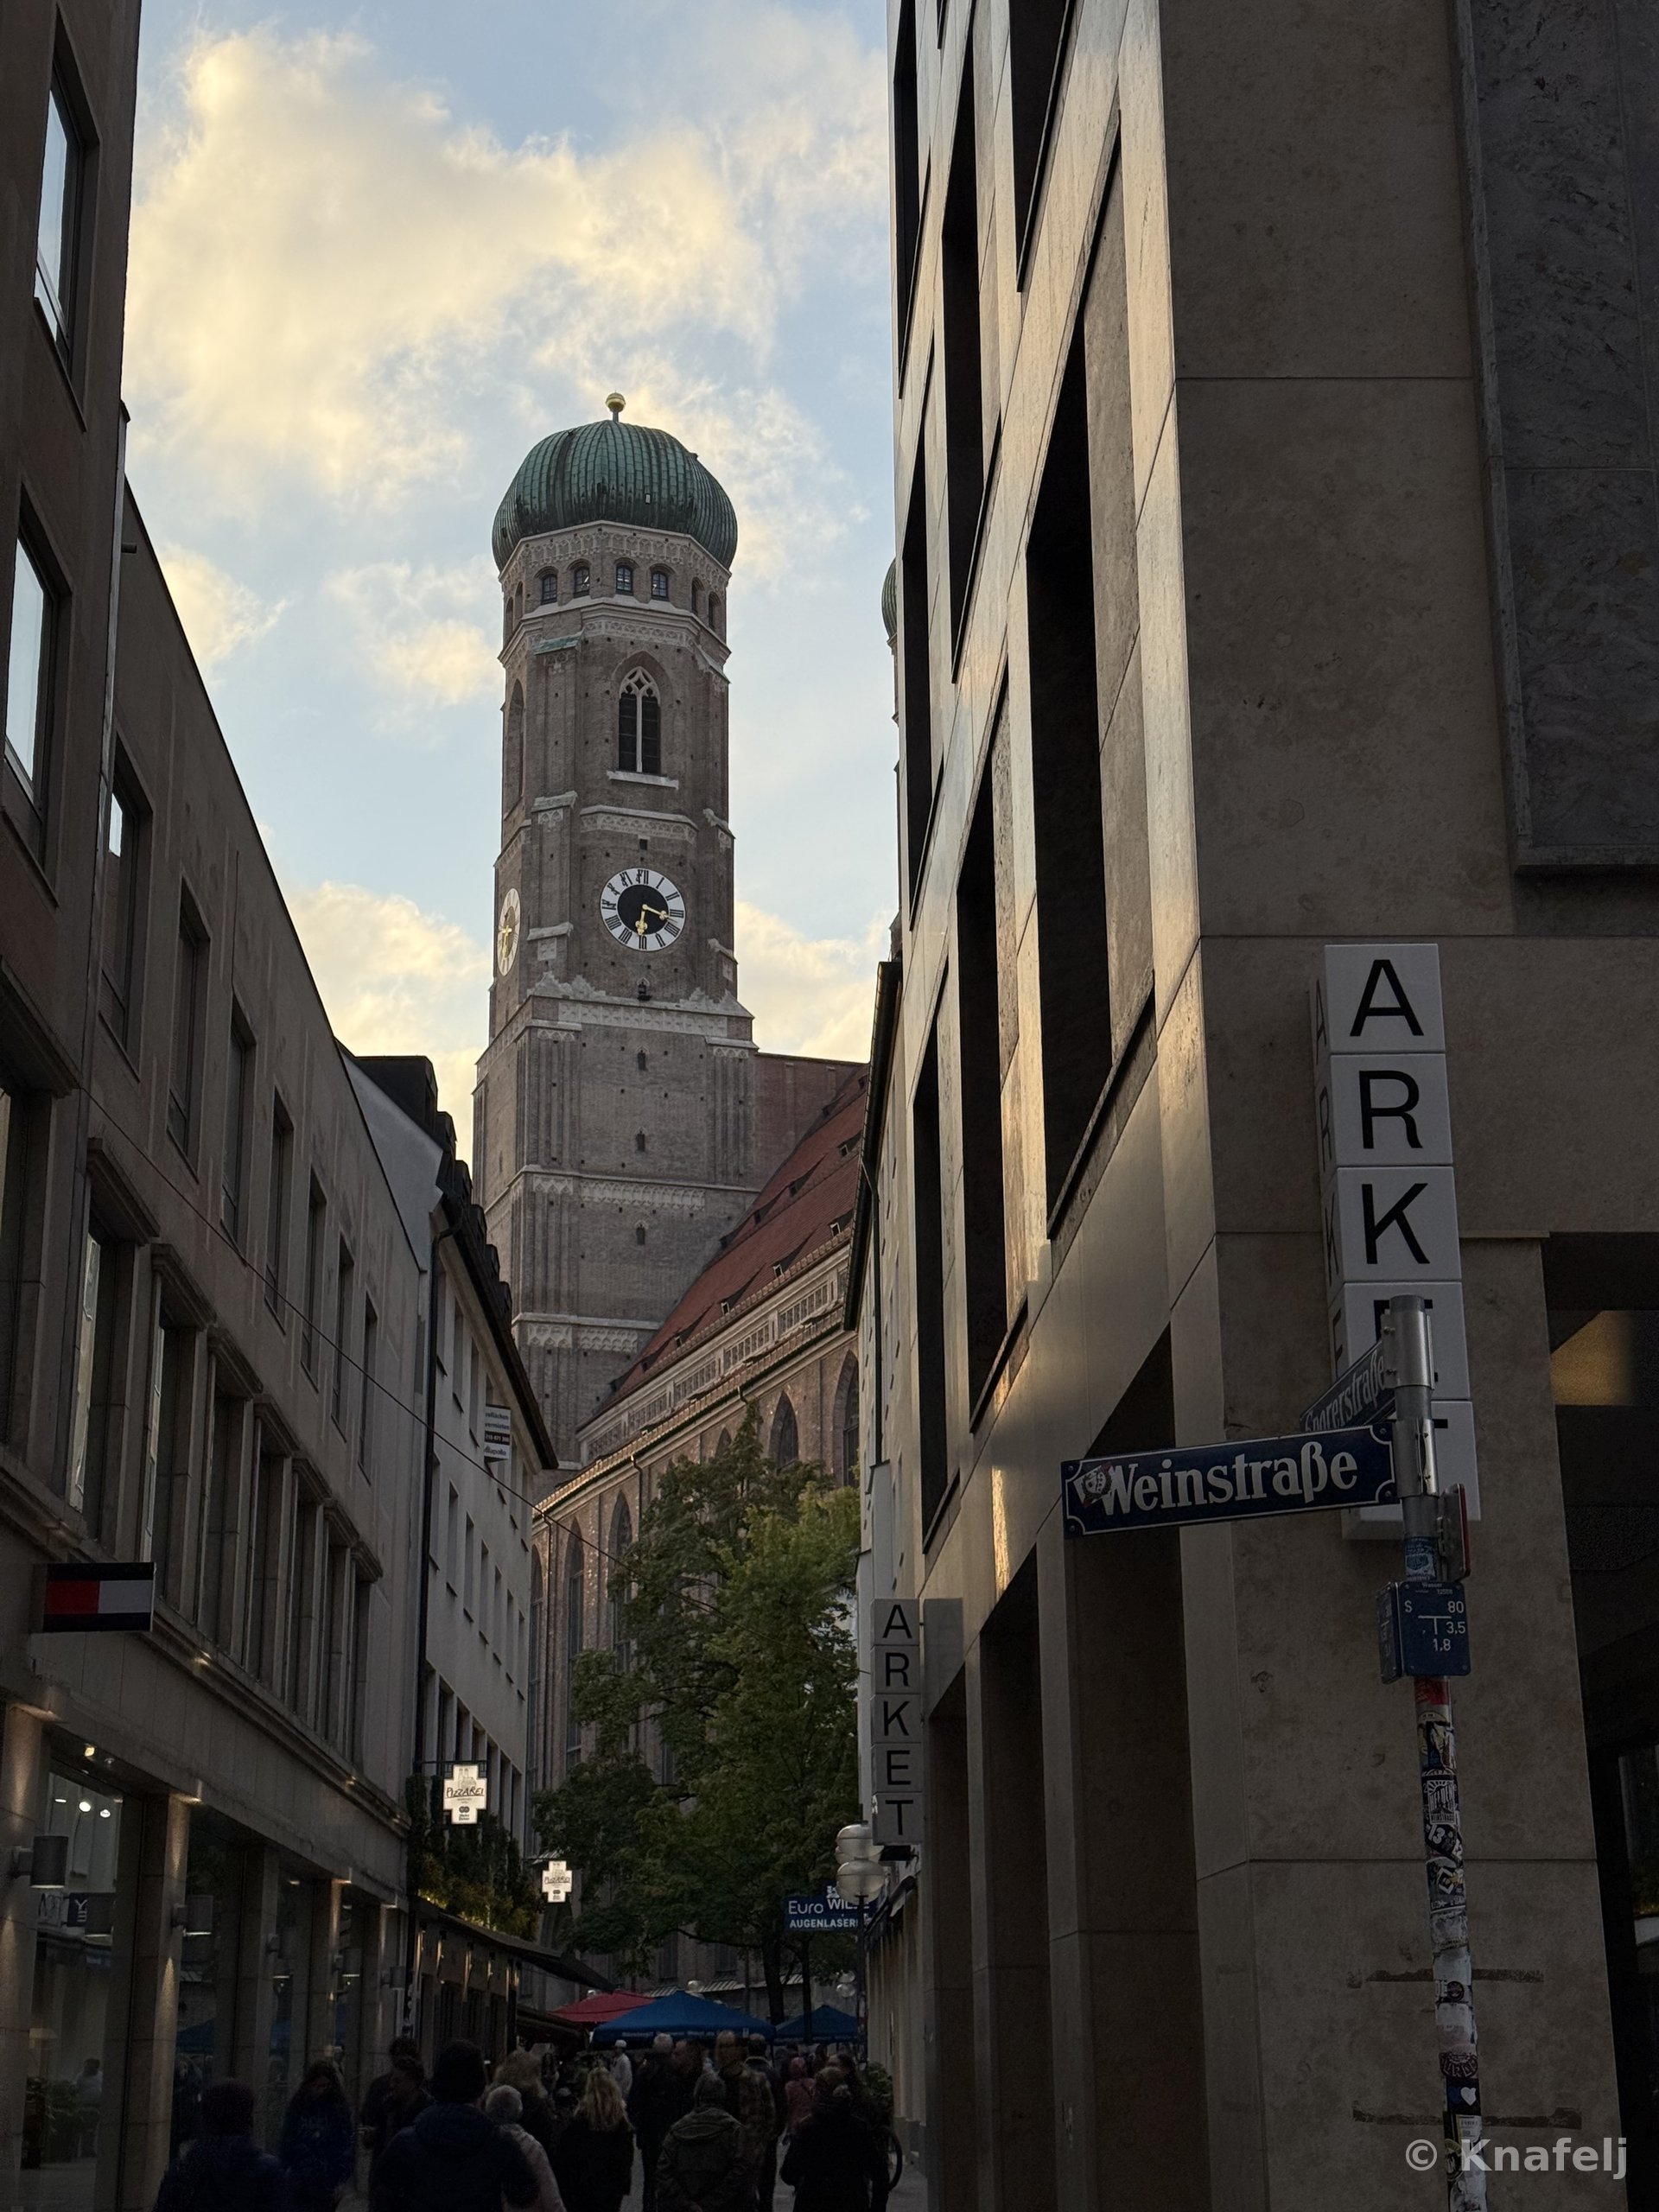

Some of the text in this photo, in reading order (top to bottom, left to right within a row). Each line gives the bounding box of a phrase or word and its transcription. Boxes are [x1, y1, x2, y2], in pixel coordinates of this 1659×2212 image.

[1350, 959, 1448, 1429] ARK
[1099, 1440, 1358, 1517] Weinstraße
[1405, 1600, 1465, 1613] S 80
[1446, 1621, 1466, 1635] 3,5
[883, 1605, 913, 1836] ARKET
[447, 1786, 485, 1798] PIZZAREI
[788, 1900, 824, 1915] Euro
[789, 1917, 859, 1929] AUGENLASER
